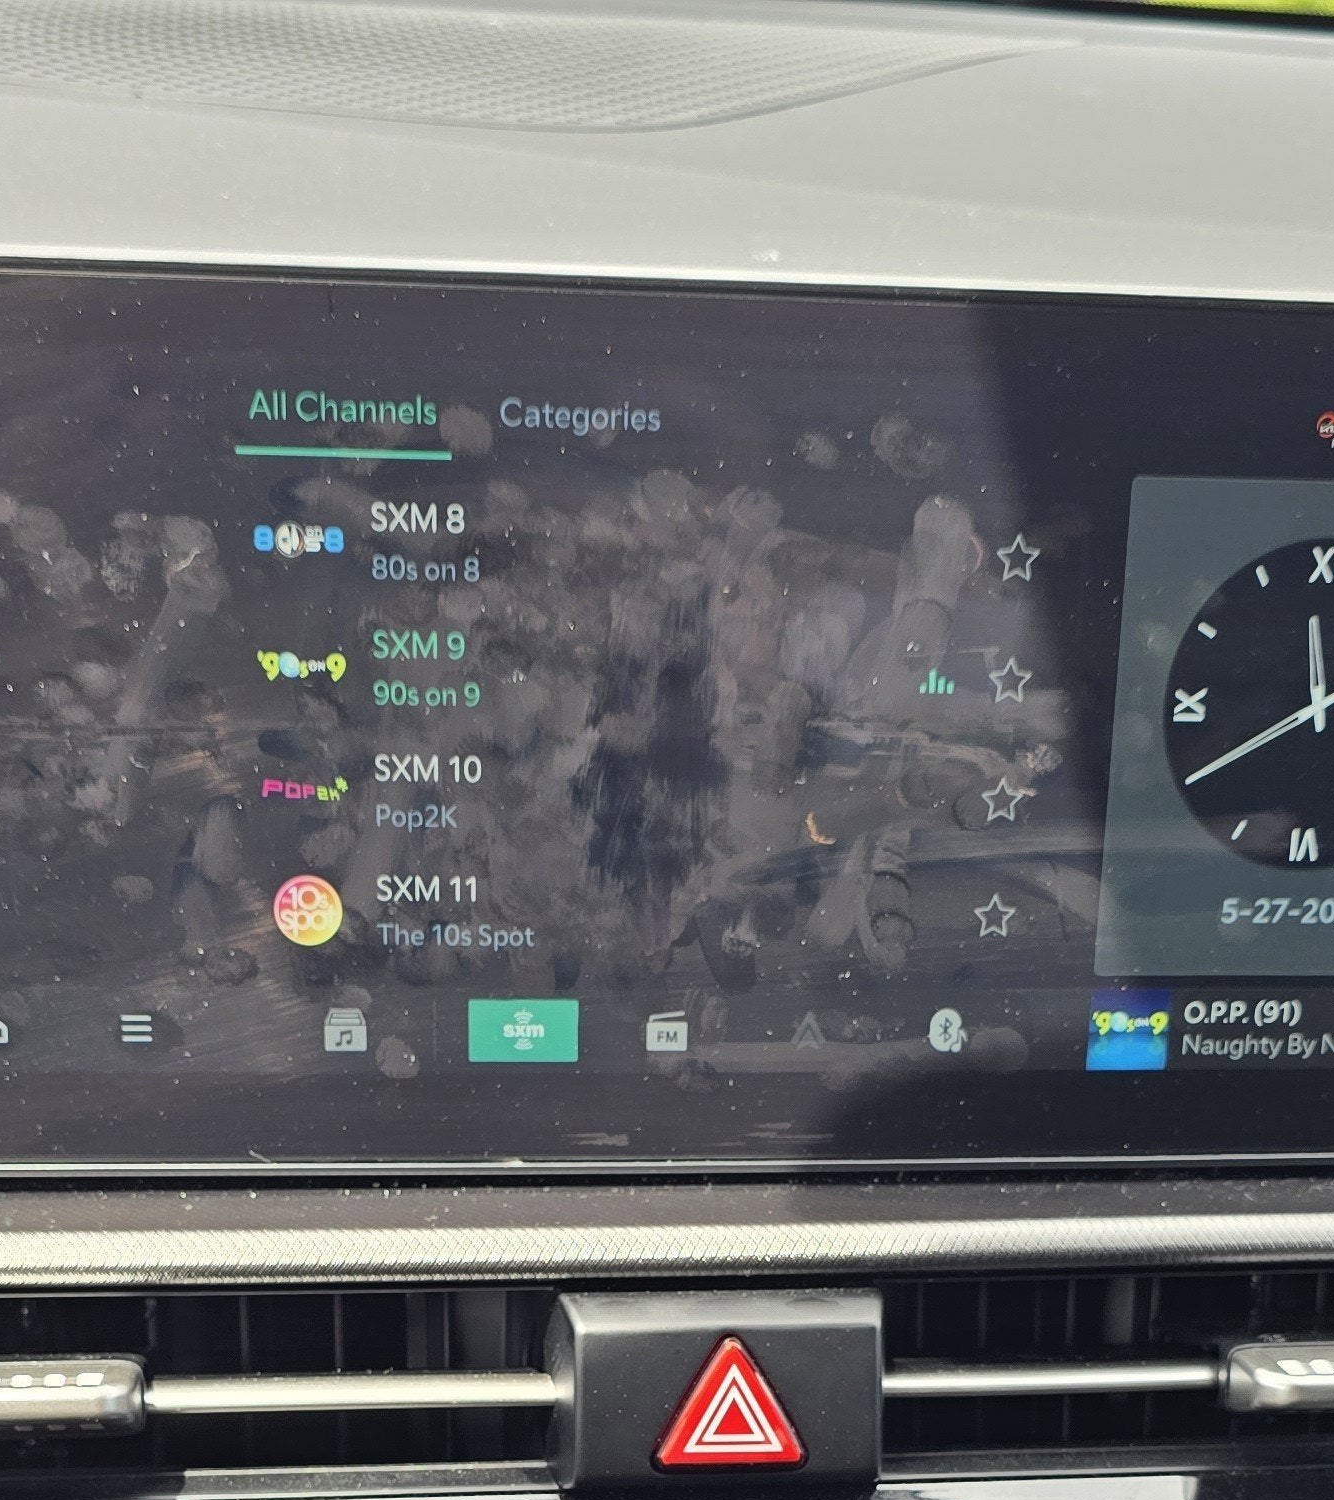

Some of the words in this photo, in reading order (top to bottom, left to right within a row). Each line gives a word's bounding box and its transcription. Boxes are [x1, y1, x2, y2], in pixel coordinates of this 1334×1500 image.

[248, 389, 287, 421] All
[295, 390, 437, 426] Channels
[499, 396, 661, 436] Categories
[370, 500, 438, 534] SXM
[446, 503, 466, 535] 8
[371, 554, 419, 582] 80s
[424, 561, 457, 582] on
[463, 555, 481, 583] 8
[372, 629, 439, 661] SXM
[446, 631, 466, 660] 9
[373, 679, 419, 707] 90s
[425, 686, 457, 707] on
[463, 681, 481, 707] 9
[374, 753, 440, 783] SXM
[449, 754, 482, 784] 10
[375, 804, 457, 833] Pop2K
[375, 874, 441, 903] SXM
[449, 876, 477, 902] 11
[377, 923, 425, 946] The
[431, 924, 472, 947] 10s
[479, 924, 535, 952] Spot
[1183, 1000, 1249, 1025] O.P.P.
[1253, 999, 1303, 1027] (91)
[503, 1023, 545, 1039] sxm
[657, 1031, 678, 1044] FM
[1181, 1033, 1284, 1061] Naughty
[1287, 1032, 1316, 1060] By
